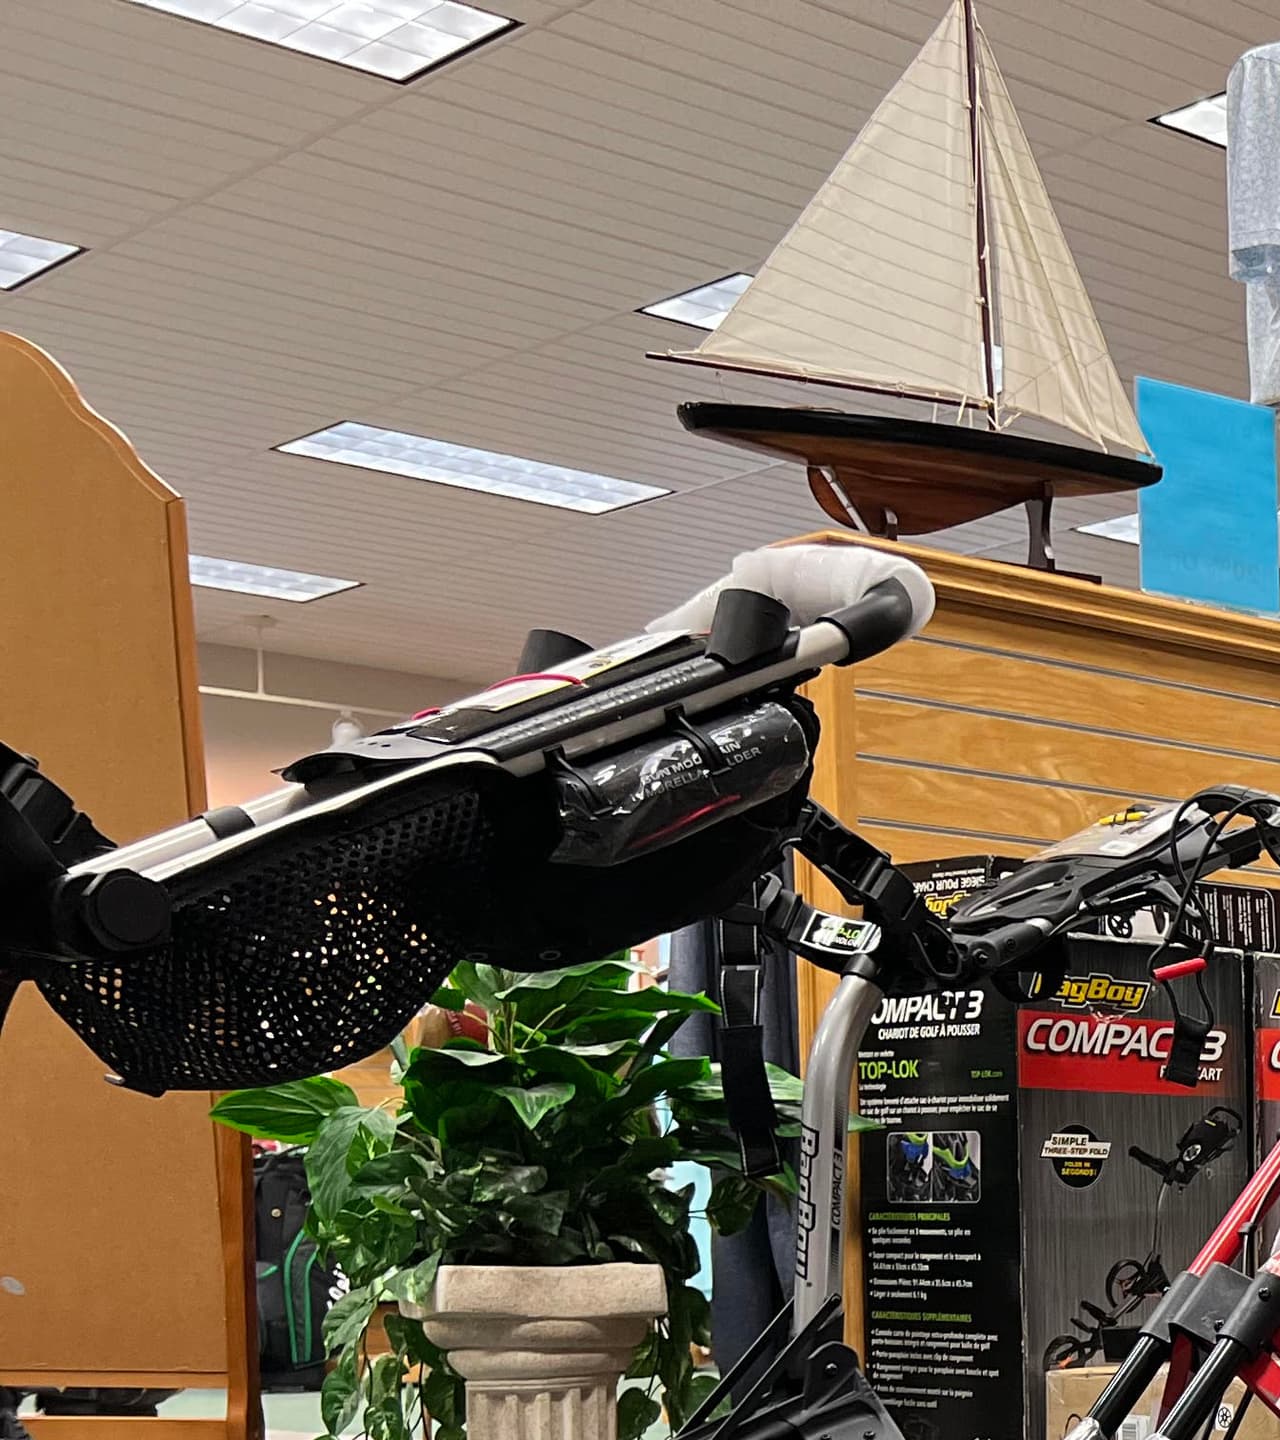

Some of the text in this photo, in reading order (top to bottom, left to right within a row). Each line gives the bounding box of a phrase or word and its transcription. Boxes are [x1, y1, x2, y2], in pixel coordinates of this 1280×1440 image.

[672, 741, 742, 777] MOUAIN
[871, 990, 985, 1025] OMPACT 3
[1034, 973, 1146, 1008] agBoy
[878, 1026, 910, 1040] CHARIOT
[909, 1026, 920, 1039] DE
[920, 1024, 940, 1038] GOLF
[946, 1023, 980, 1037] POUSSER
[1026, 1018, 1175, 1059] COMPAC
[1199, 1030, 1227, 1062] 3
[858, 1059, 920, 1080] TOP-LOK
[1052, 1135, 1088, 1146] SIMPLE
[830, 1153, 844, 1226] COMPACT 3
